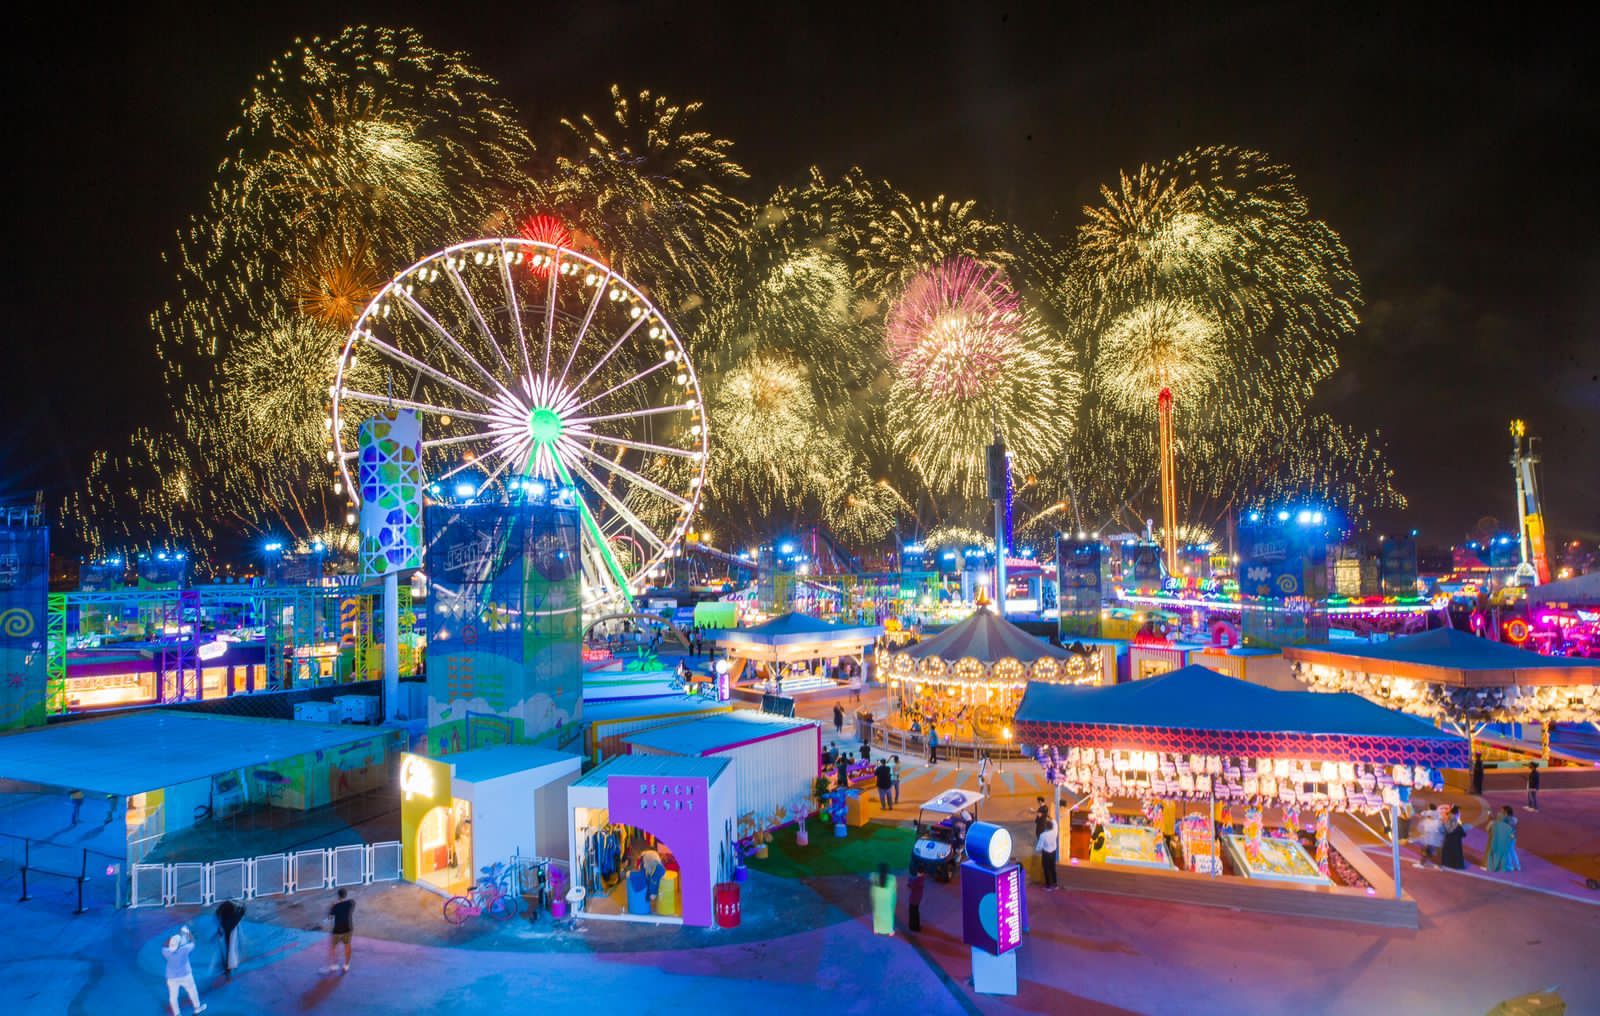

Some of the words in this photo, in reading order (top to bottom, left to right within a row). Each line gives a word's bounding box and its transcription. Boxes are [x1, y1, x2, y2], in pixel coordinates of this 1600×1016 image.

[1164, 577, 1195, 589] GRAND
[1196, 578, 1216, 592] PRIX
[640, 784, 694, 795] BEACH
